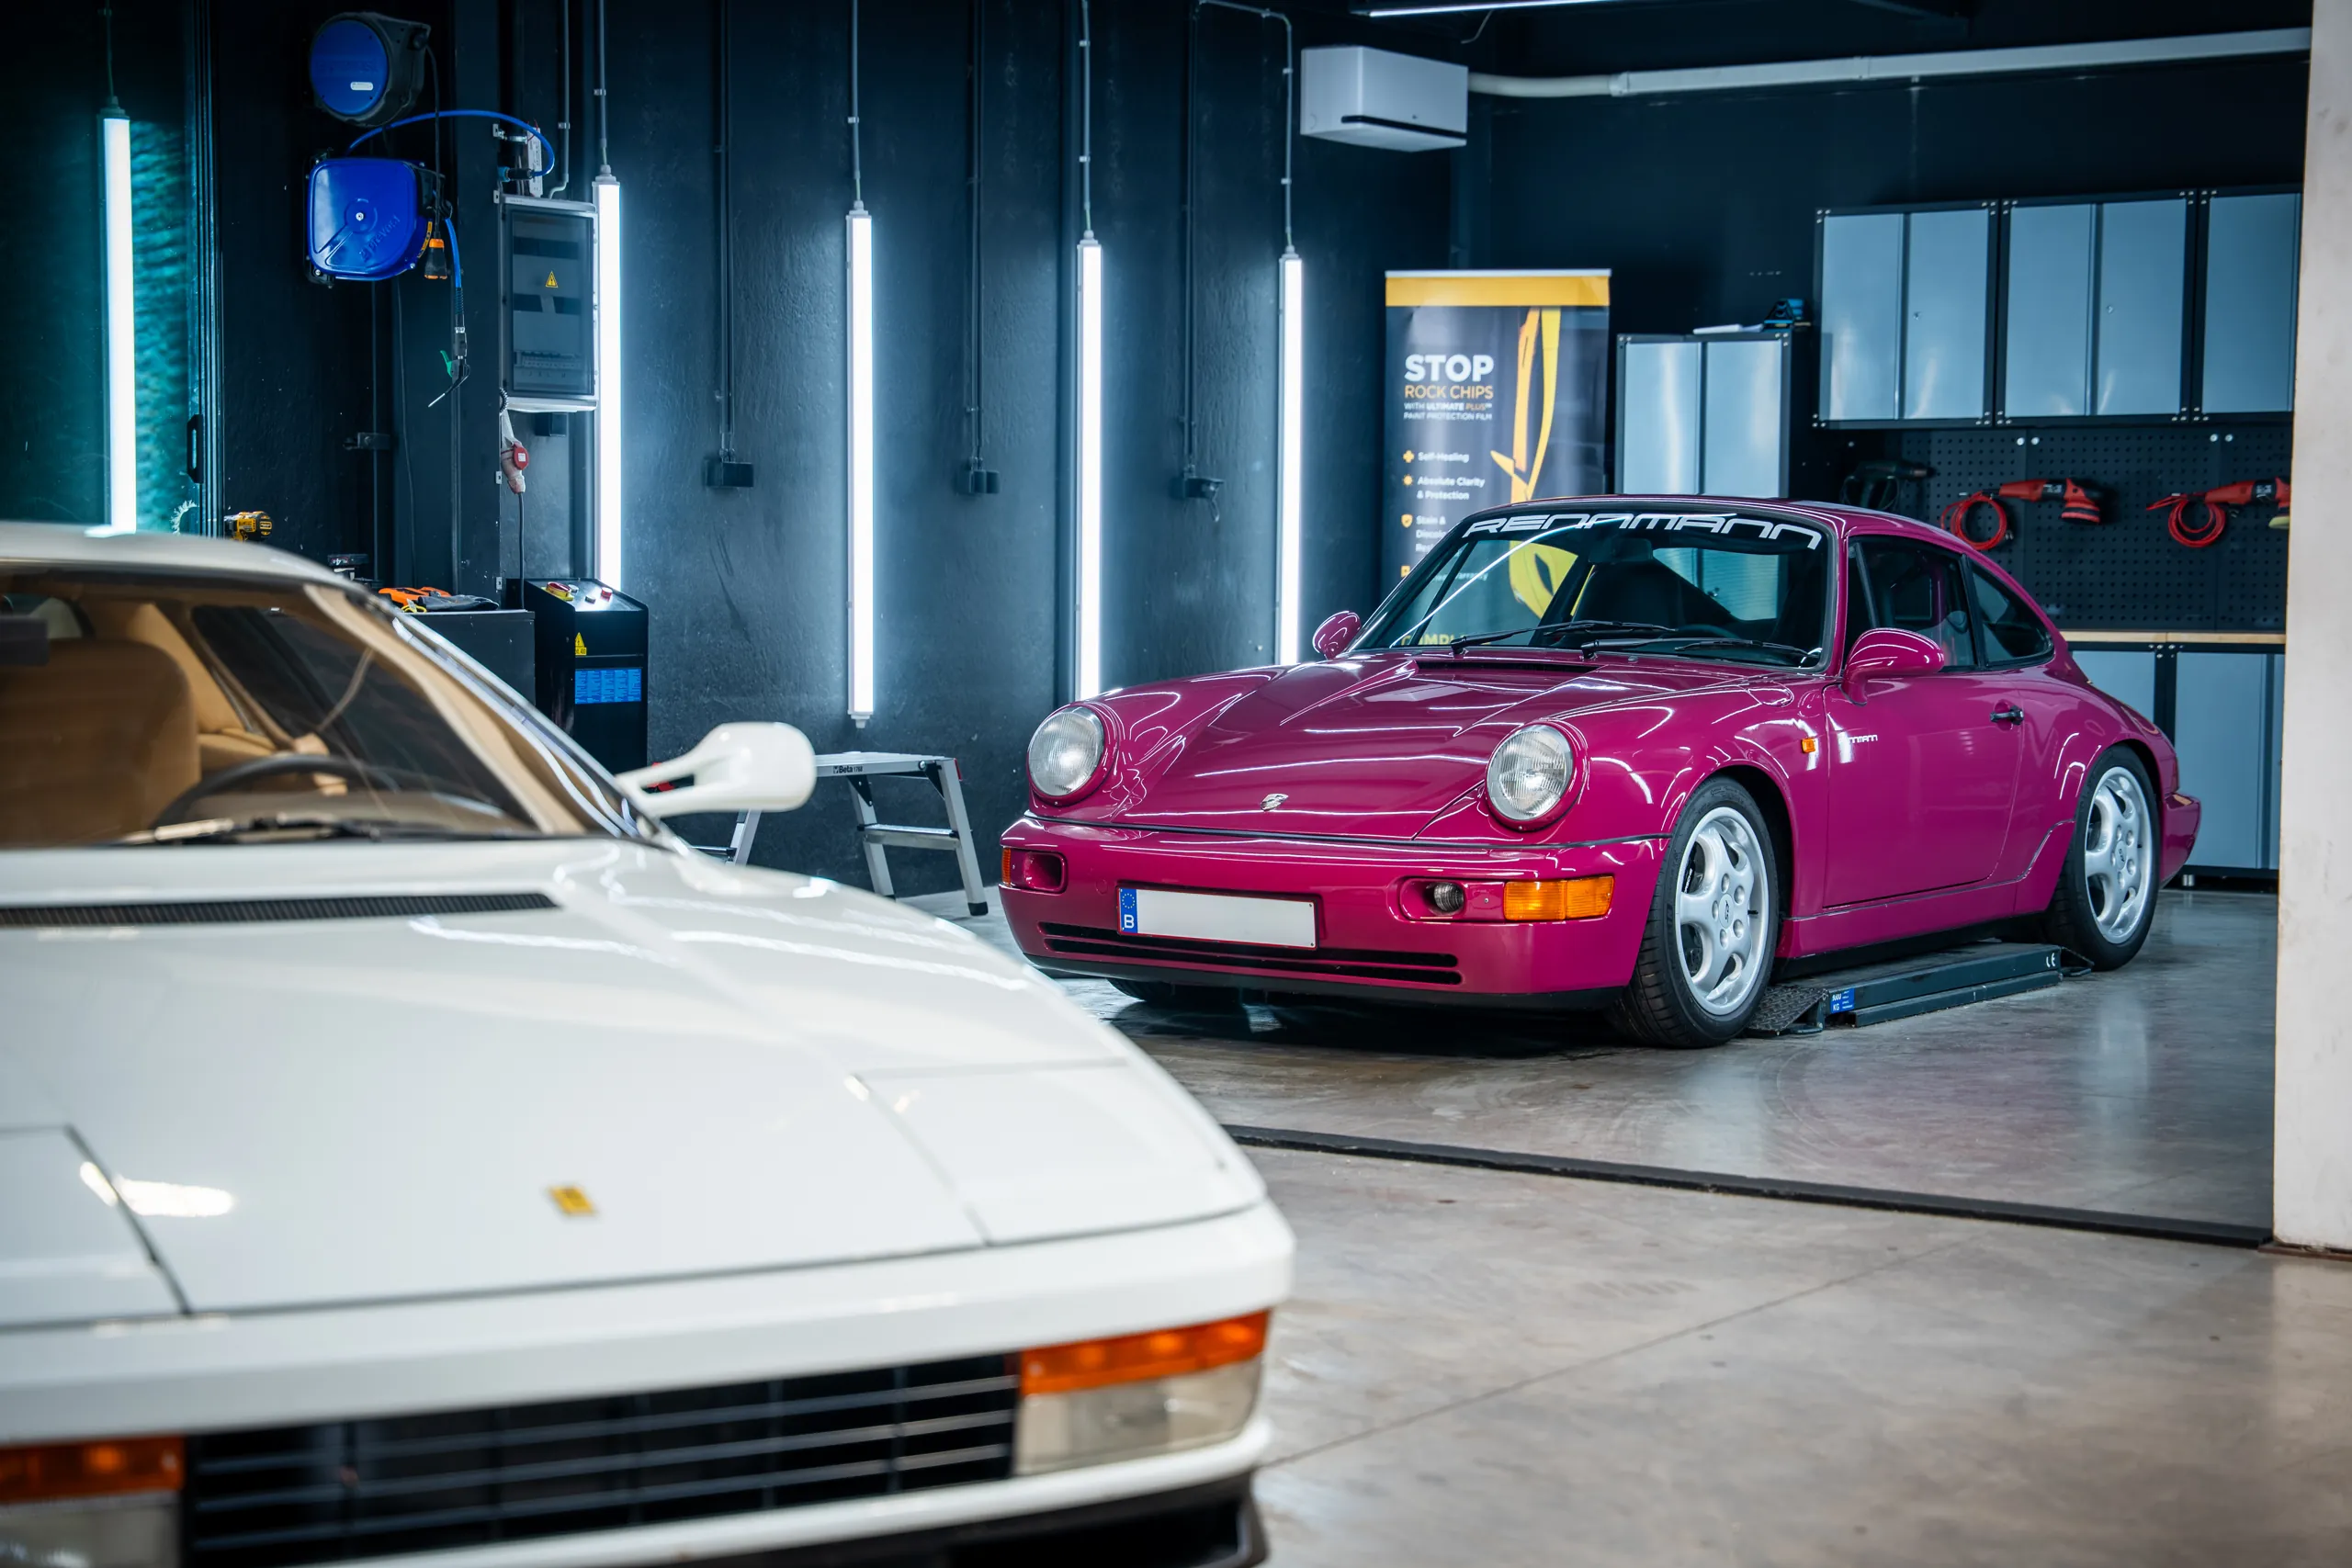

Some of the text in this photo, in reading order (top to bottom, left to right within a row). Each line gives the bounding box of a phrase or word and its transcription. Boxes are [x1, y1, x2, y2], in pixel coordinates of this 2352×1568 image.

[1404, 354, 1494, 382] STOP
[1405, 384, 1494, 400] ROCK CHIPS
[1456, 477, 1486, 488] Clarity
[1425, 491, 1470, 500] Protection
[1462, 513, 1823, 550] RENNMANN
[839, 764, 853, 773] Beta
[1124, 914, 1135, 929] B
